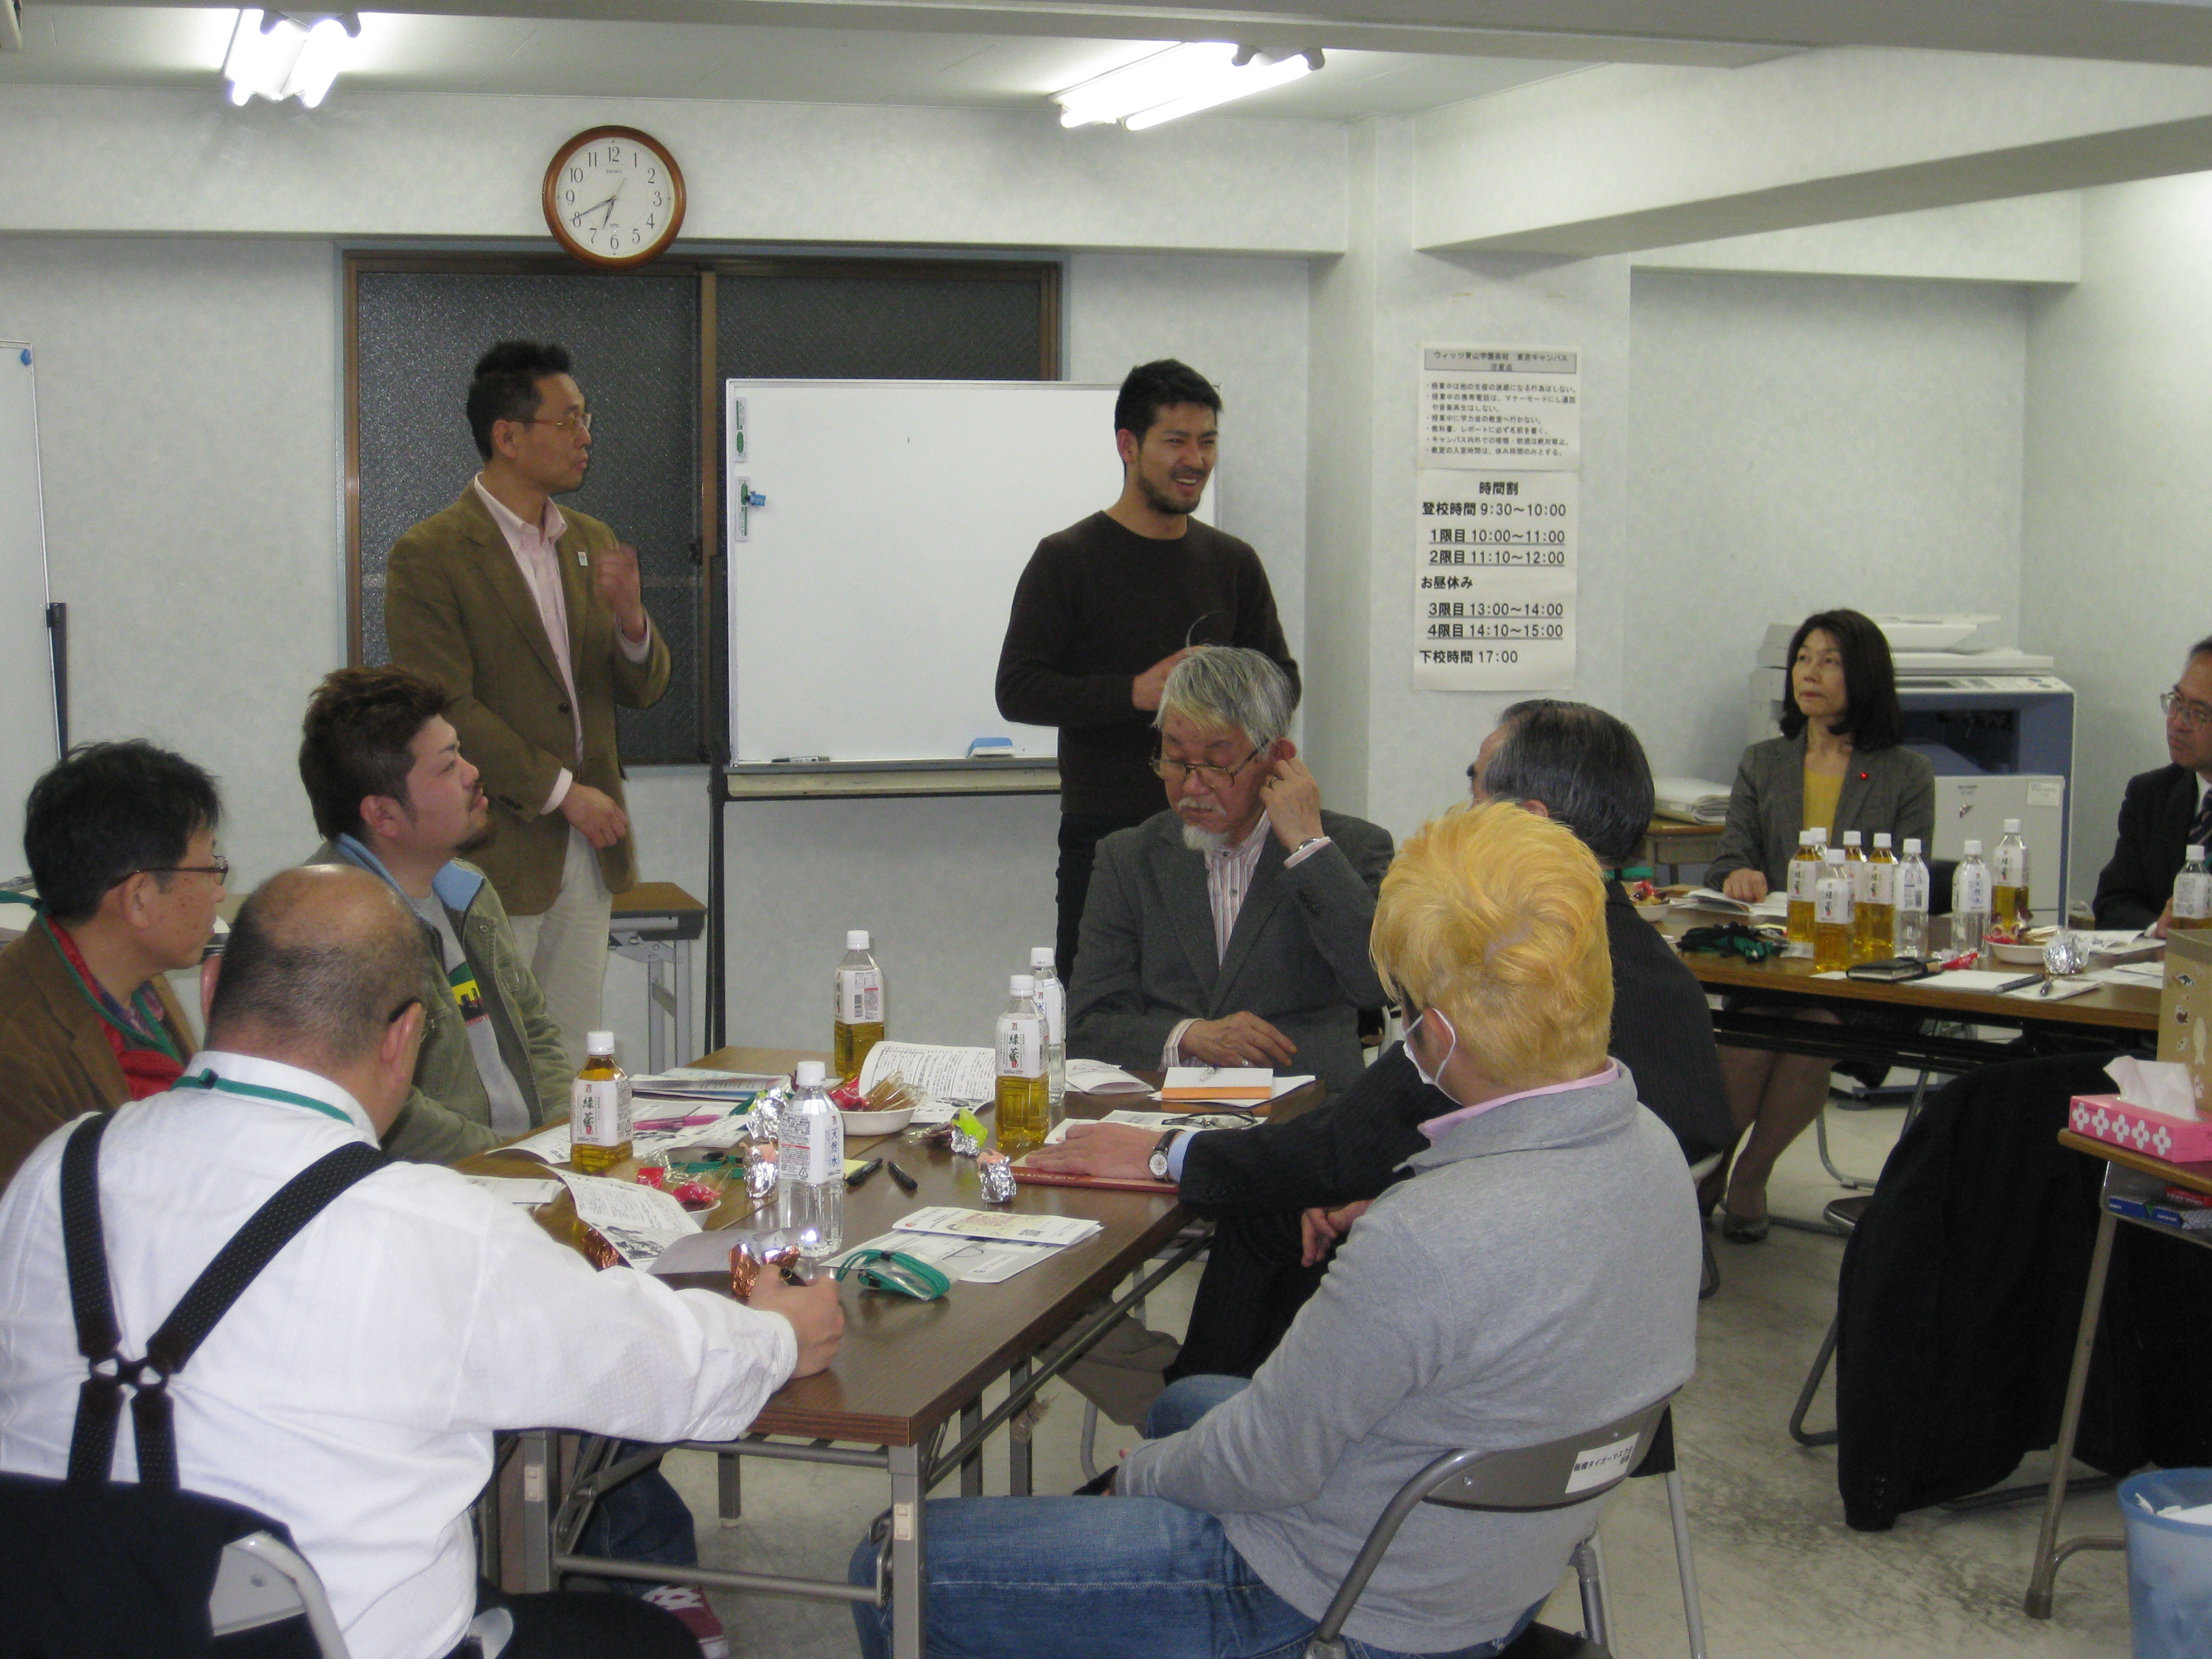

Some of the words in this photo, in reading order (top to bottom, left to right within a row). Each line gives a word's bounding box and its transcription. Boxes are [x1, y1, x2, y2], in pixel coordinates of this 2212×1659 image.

[588, 152, 597, 167] 11
[608, 146, 620, 162] 12
[634, 152, 637, 167] 1
[570, 167, 583, 183] 10
[647, 168, 655, 184] 2
[566, 189, 575, 205] 9
[653, 191, 662, 207] 3
[572, 212, 581, 227] 8
[646, 213, 655, 229] 4
[589, 227, 597, 244] 7
[610, 235, 619, 250] 6
[632, 229, 640, 244] 5
[1479, 481, 1518, 495] 時間割
[1423, 502, 1476, 515] 登校時間
[1431, 529, 1465, 542] 1限目
[1430, 551, 1465, 563] 2限目
[1421, 576, 1473, 589] お昼休み
[1429, 603, 1464, 616] 3限目
[1428, 624, 1464, 637] 4限目
[1419, 650, 1473, 663] 下校時間
[1478, 651, 1518, 663] 17:00
[1009, 1033, 1020, 1062] 緑茶
[582, 1096, 594, 1127] 緑茶
